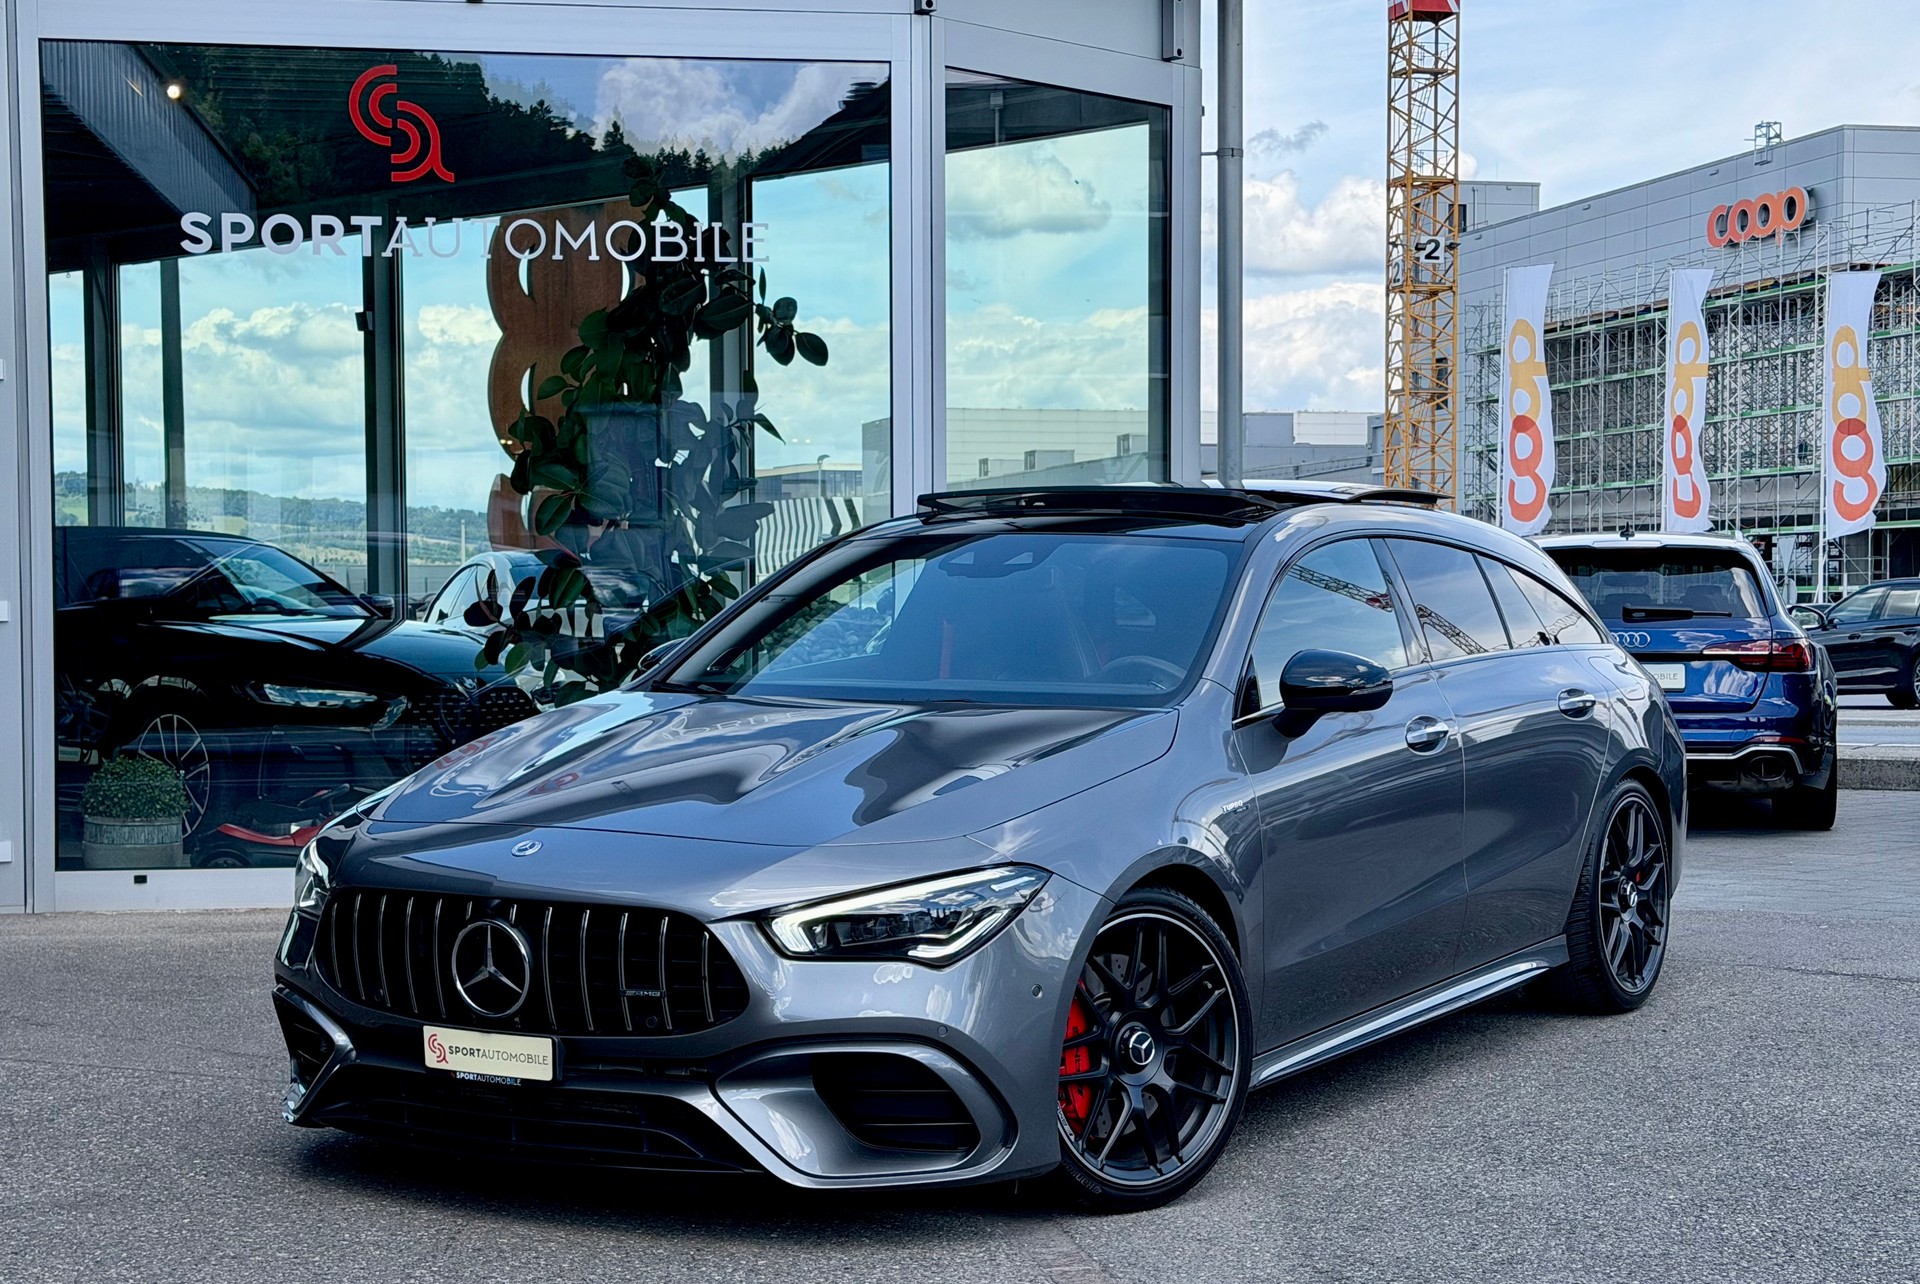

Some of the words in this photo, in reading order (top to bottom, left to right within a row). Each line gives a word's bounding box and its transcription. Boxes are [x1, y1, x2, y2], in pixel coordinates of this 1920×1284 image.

[1706, 186, 1806, 249] coop
[180, 211, 771, 263] SPORTAUTOMOBILE
[1424, 238, 1441, 260] 2
[448, 1045, 549, 1066] SPORTAUTOMOBILE
[456, 1071, 522, 1087] SPORTAUTOMOBILE
